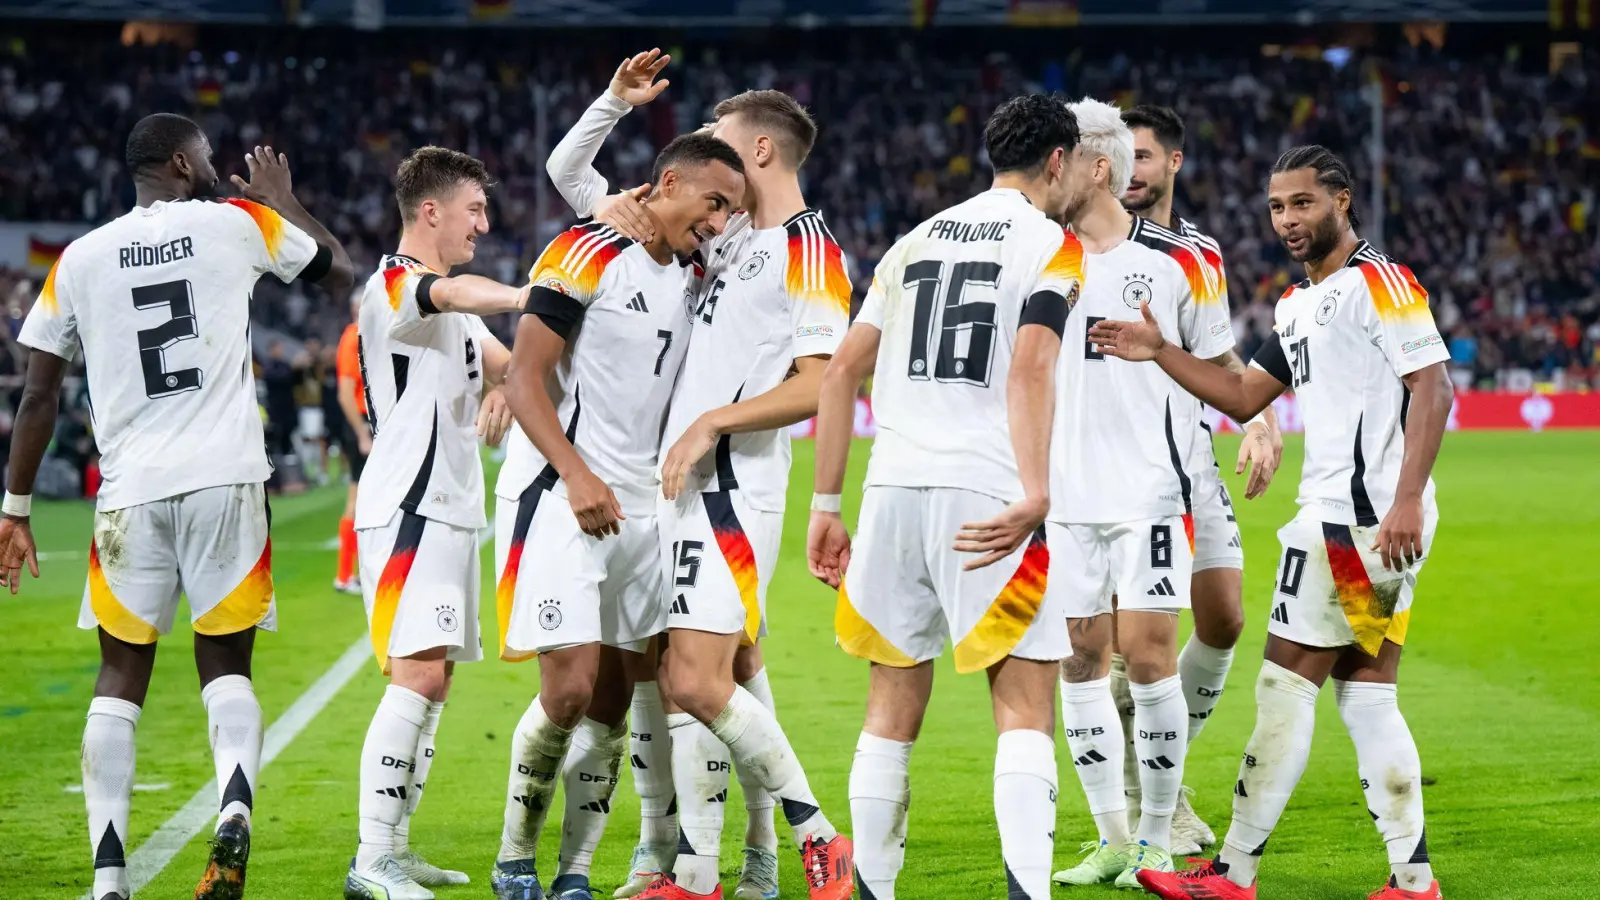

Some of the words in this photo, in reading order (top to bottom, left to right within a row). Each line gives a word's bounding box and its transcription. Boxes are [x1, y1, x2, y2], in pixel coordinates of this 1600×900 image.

[927, 219, 1012, 243] PAVLOVIĆ
[119, 236, 194, 268] RÜDIGER
[131, 279, 203, 400] 2
[903, 260, 1003, 388] 16
[654, 329, 673, 377] 7
[1151, 525, 1173, 569] 8
[1066, 726, 1105, 738] DFB
[1139, 730, 1177, 741] DFB
